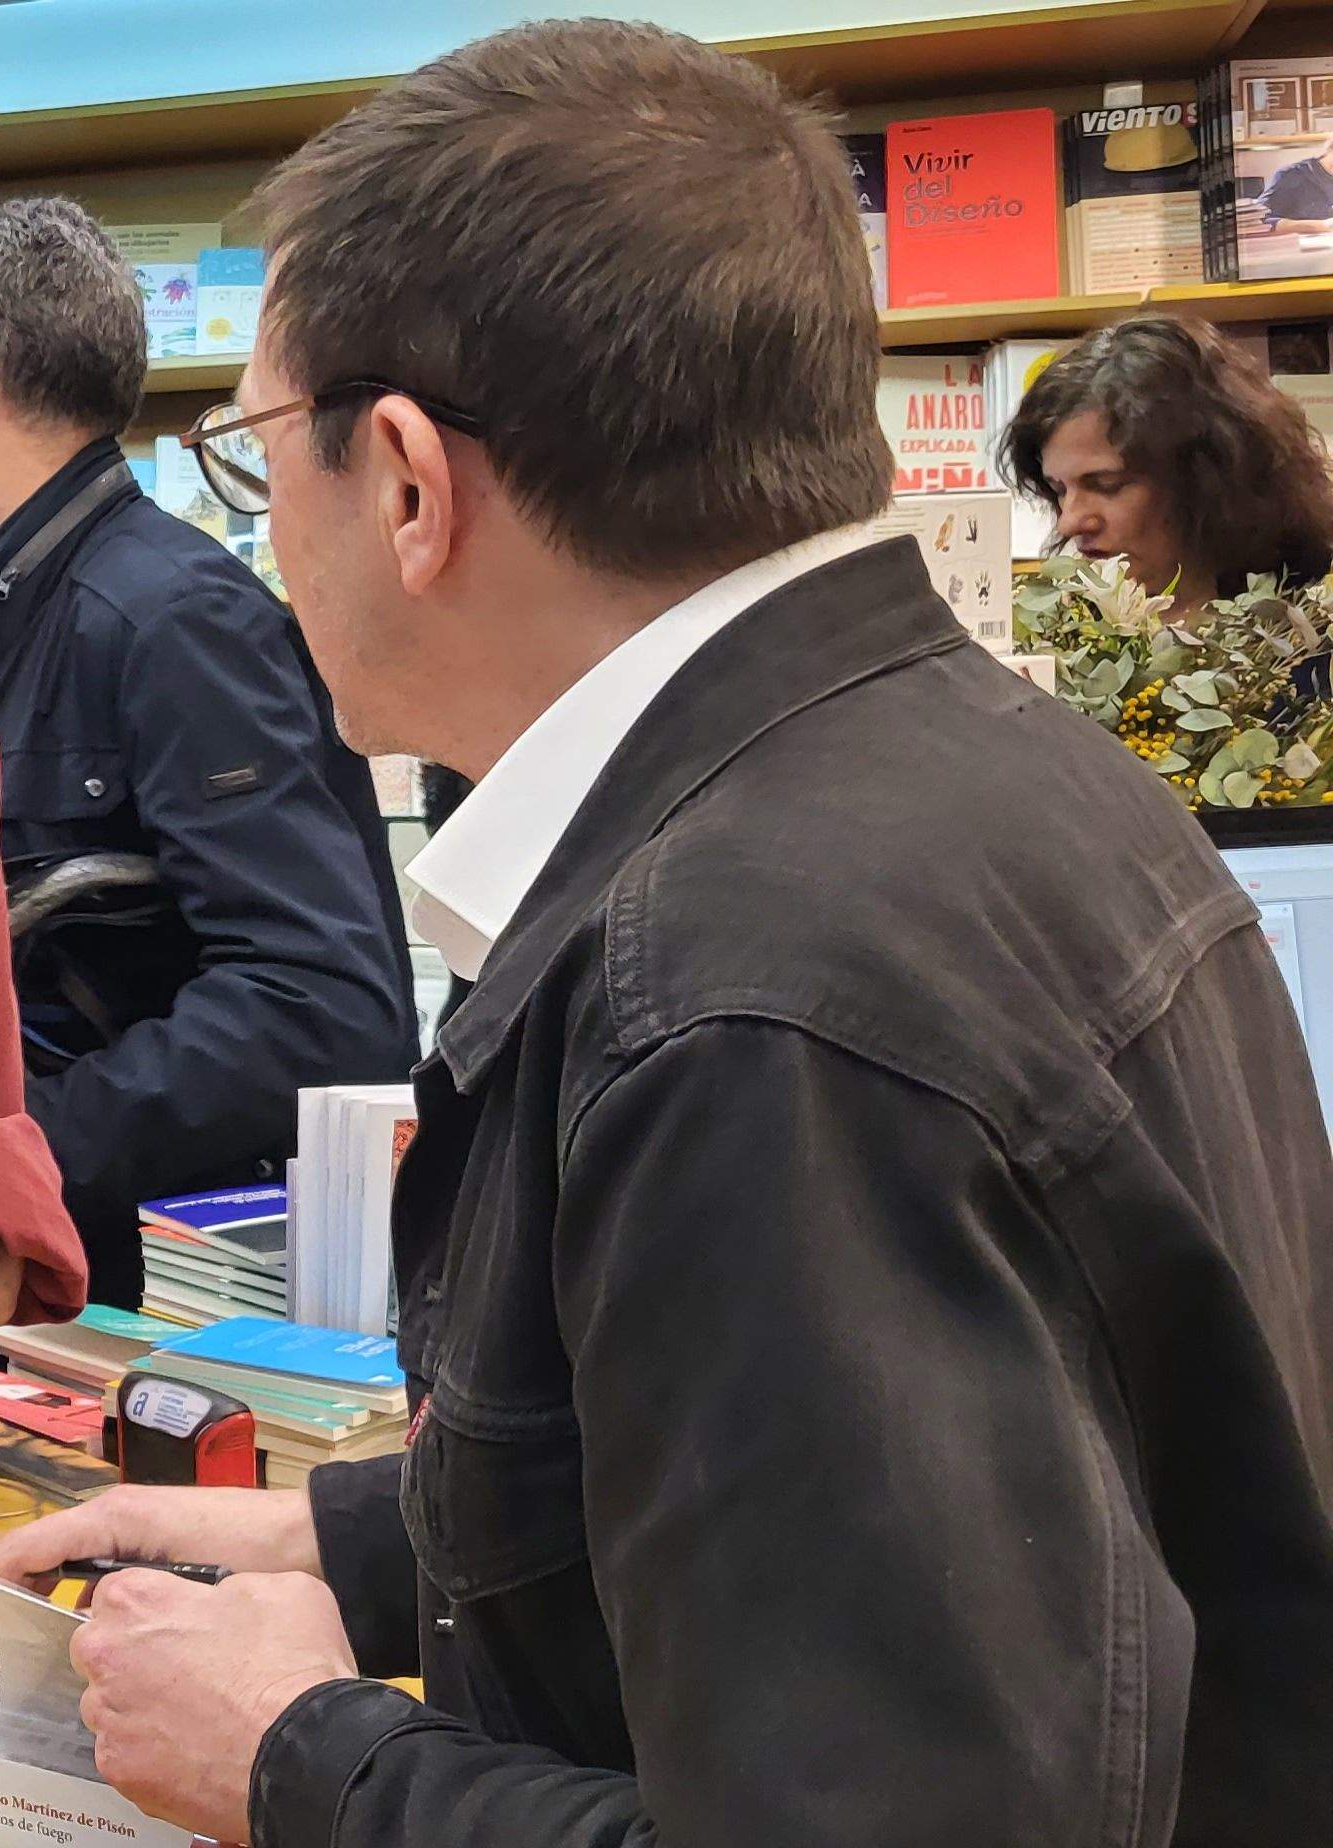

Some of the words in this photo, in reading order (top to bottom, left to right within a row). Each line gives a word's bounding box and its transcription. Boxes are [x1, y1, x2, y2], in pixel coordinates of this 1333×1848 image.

[903, 149, 974, 174] Vivir
[904, 176, 952, 201] del
[903, 195, 1023, 228] Diseño
[899, 439, 978, 454] EXPLICADA
[11, 1795, 74, 1823] Martínez
[76, 1812, 94, 1828] de
[97, 1817, 136, 1839] Pisón
[17, 1816, 34, 1833] de
